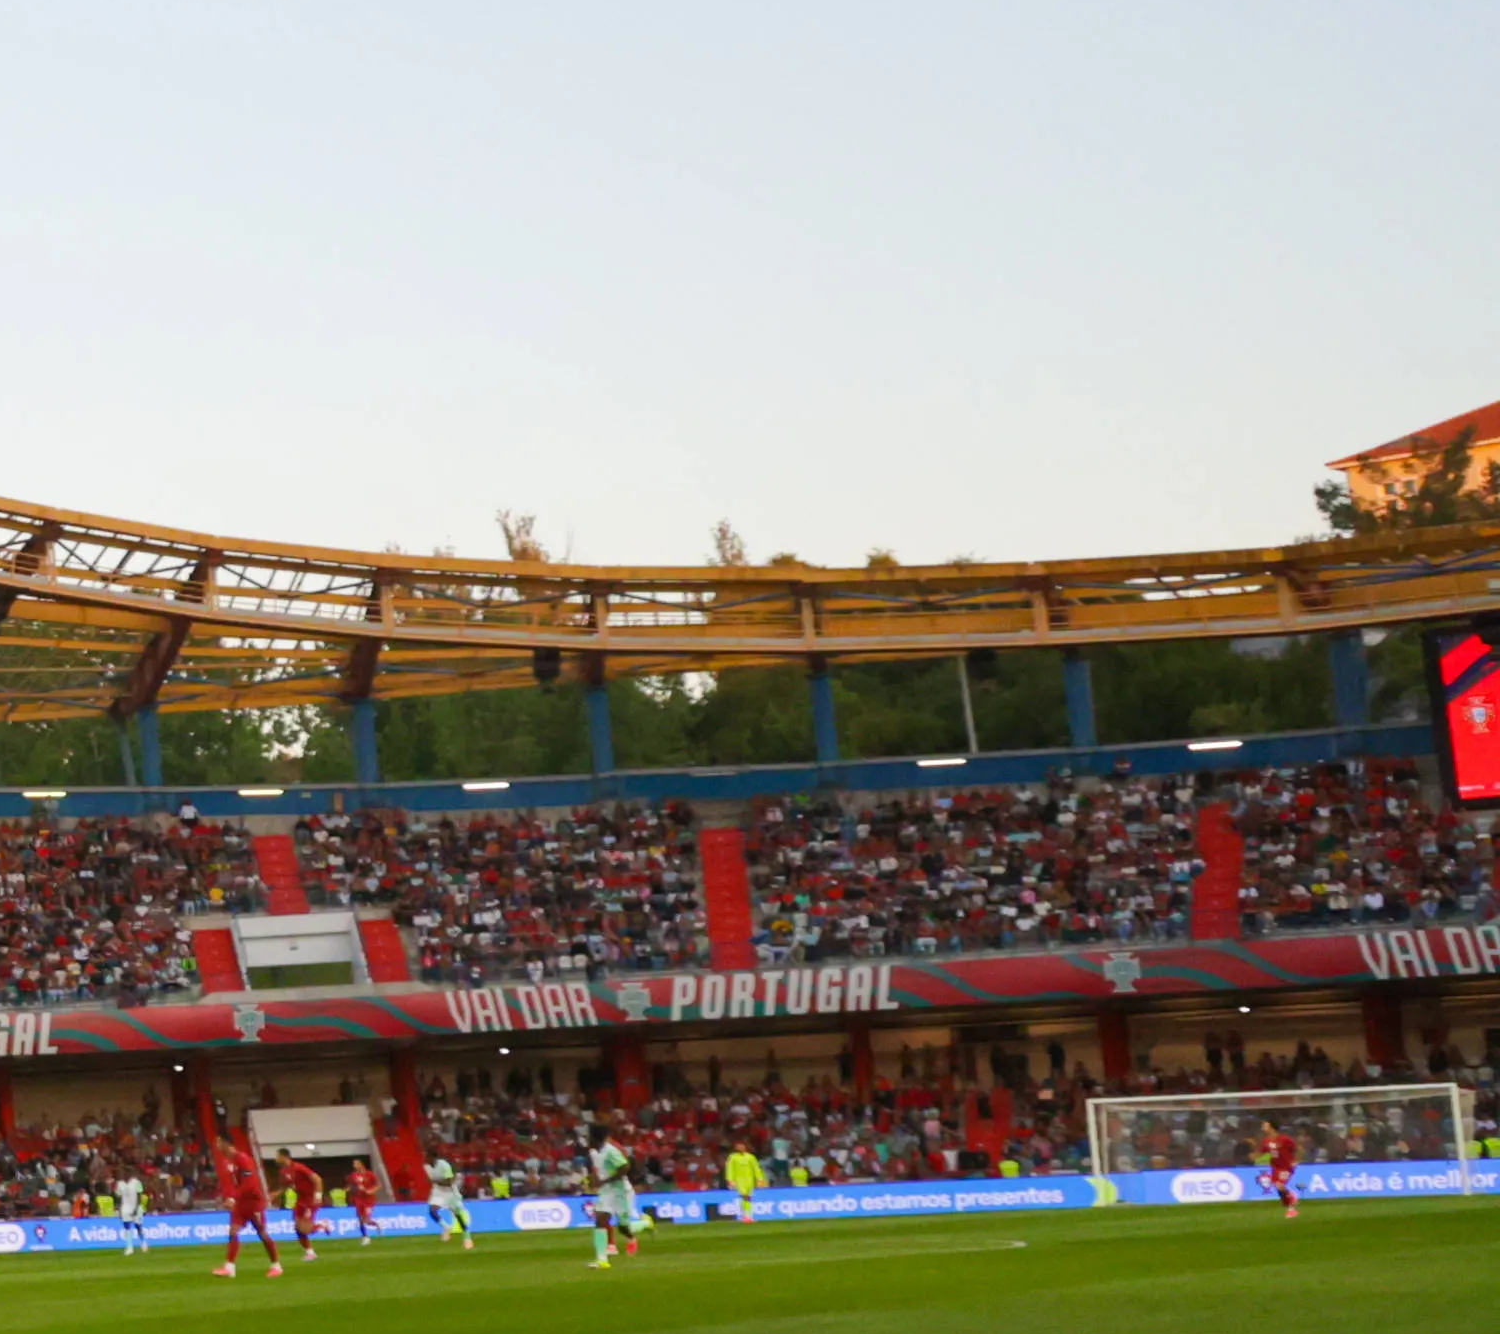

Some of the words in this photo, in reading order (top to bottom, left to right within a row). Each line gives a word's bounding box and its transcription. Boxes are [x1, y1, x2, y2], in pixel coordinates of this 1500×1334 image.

[1357, 929, 1439, 980] VAI
[445, 988, 513, 1033] VAI
[516, 982, 599, 1030] DAR
[670, 965, 899, 1022] PORTUGAL
[1181, 1179, 1233, 1195] MEO
[1310, 1174, 1328, 1193] A
[1332, 1172, 1383, 1192] vida
[1389, 1171, 1403, 1190] é
[779, 1194, 857, 1216] quando
[862, 1191, 951, 1210] estamos
[956, 1187, 1064, 1210] presentes
[521, 1210, 564, 1223] MEO
[69, 1227, 81, 1241] A
[83, 1225, 117, 1241] vida
